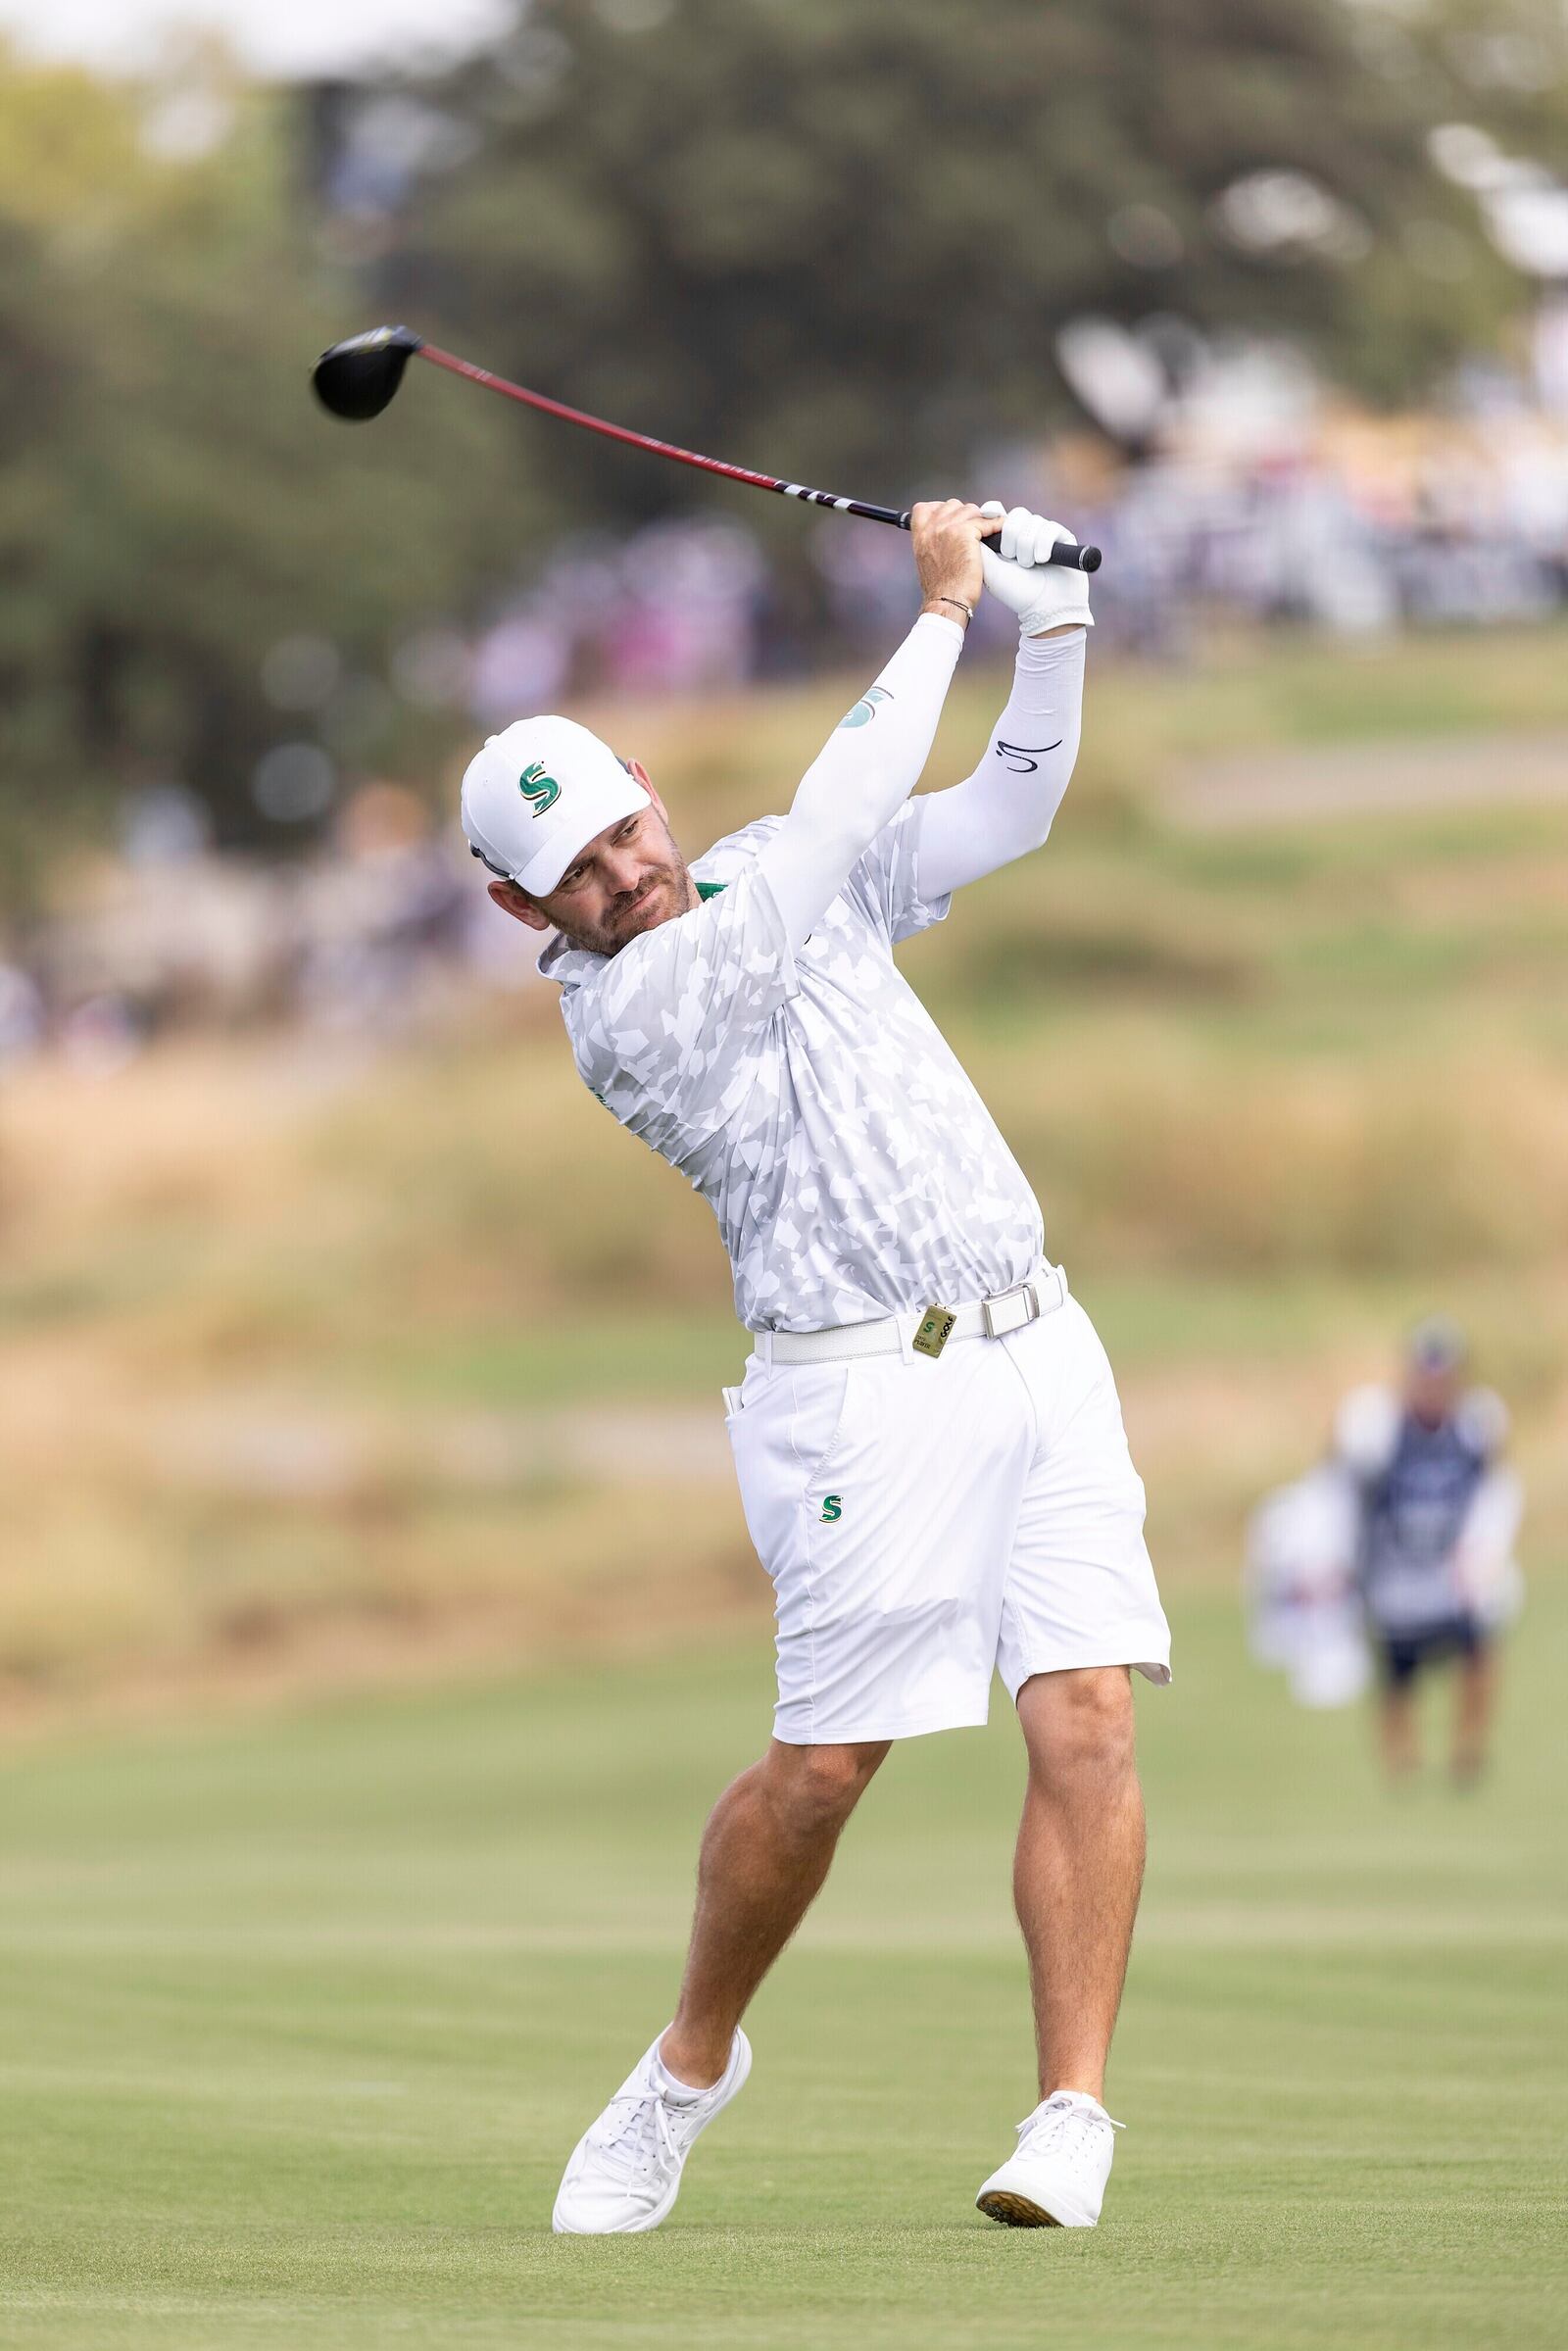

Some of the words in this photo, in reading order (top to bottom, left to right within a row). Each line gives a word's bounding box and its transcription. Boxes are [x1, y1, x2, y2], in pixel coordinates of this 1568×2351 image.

[518, 760, 563, 818] S
[941, 1316, 954, 1338] GOLF
[818, 1494, 844, 1524] S
